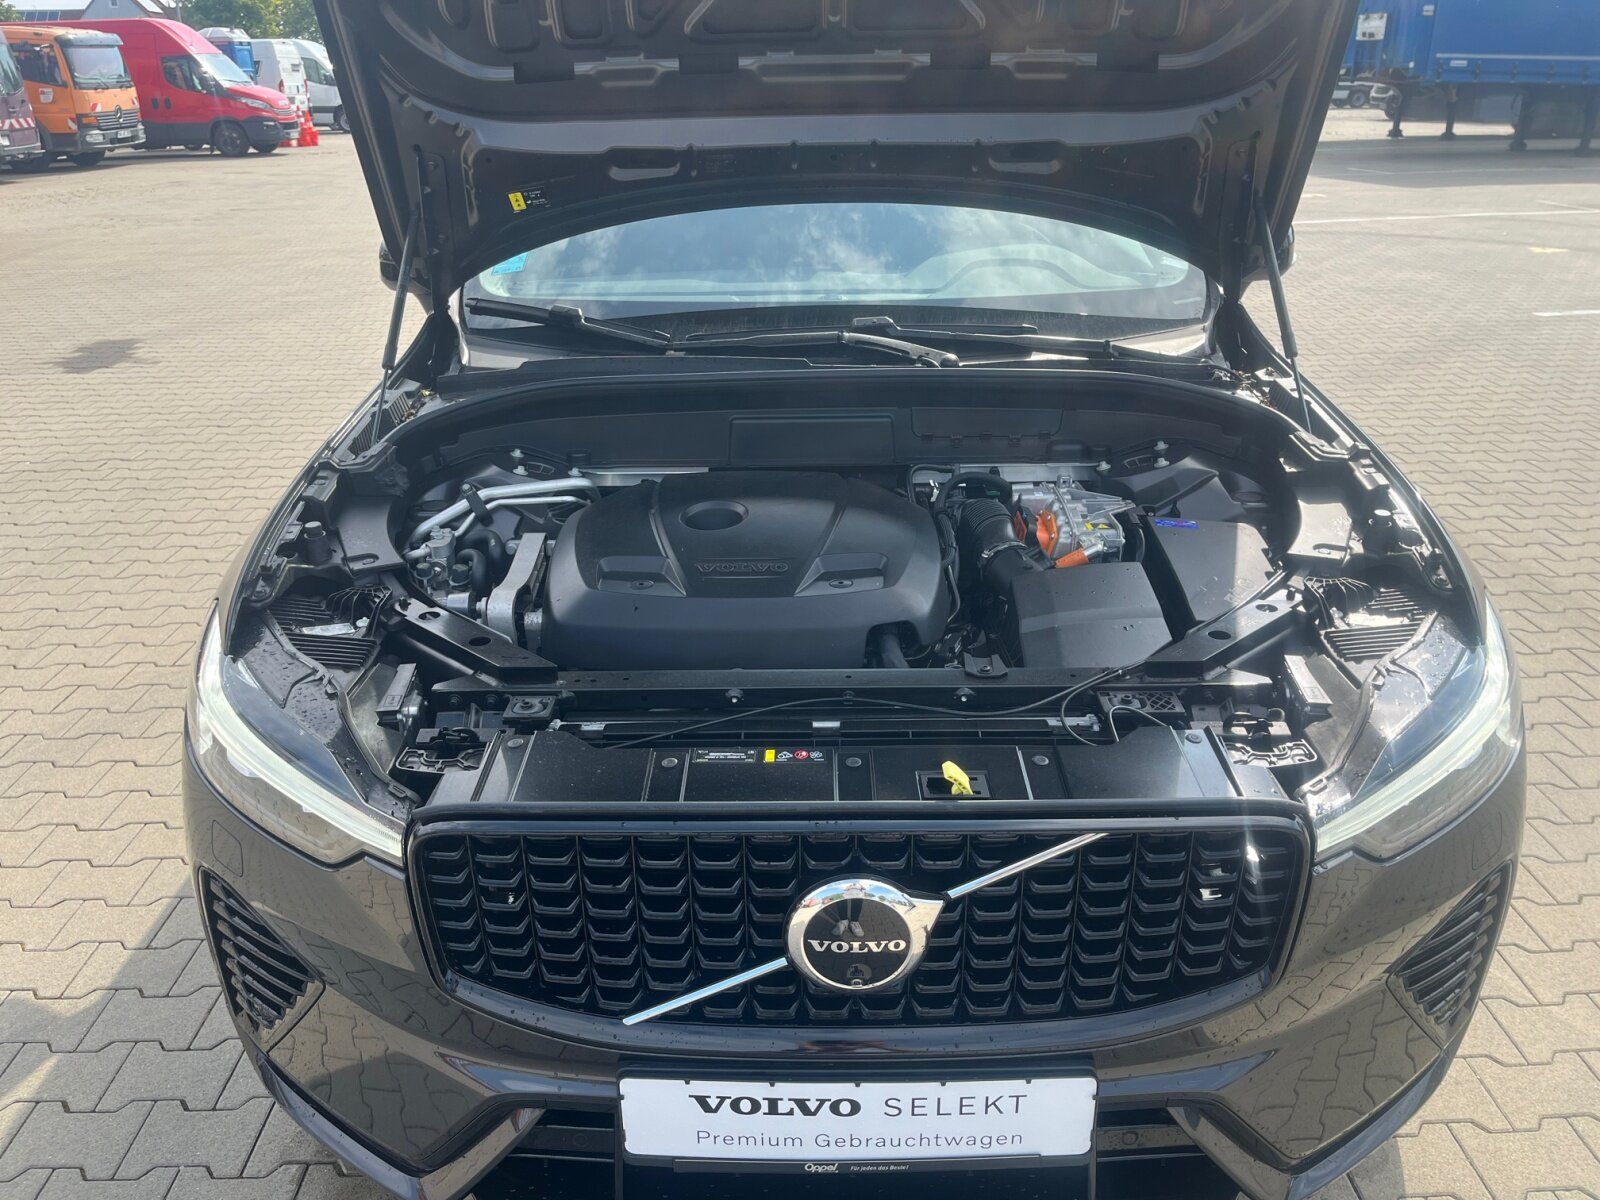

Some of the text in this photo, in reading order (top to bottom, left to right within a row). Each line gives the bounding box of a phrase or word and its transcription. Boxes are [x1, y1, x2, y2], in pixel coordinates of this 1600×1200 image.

[694, 561, 790, 573] VOLVO
[807, 939, 907, 953] VOLVO
[688, 1094, 1028, 1118] VOLVO SELEKT
[696, 1130, 1023, 1149] Premium Gebrauchtwagen
